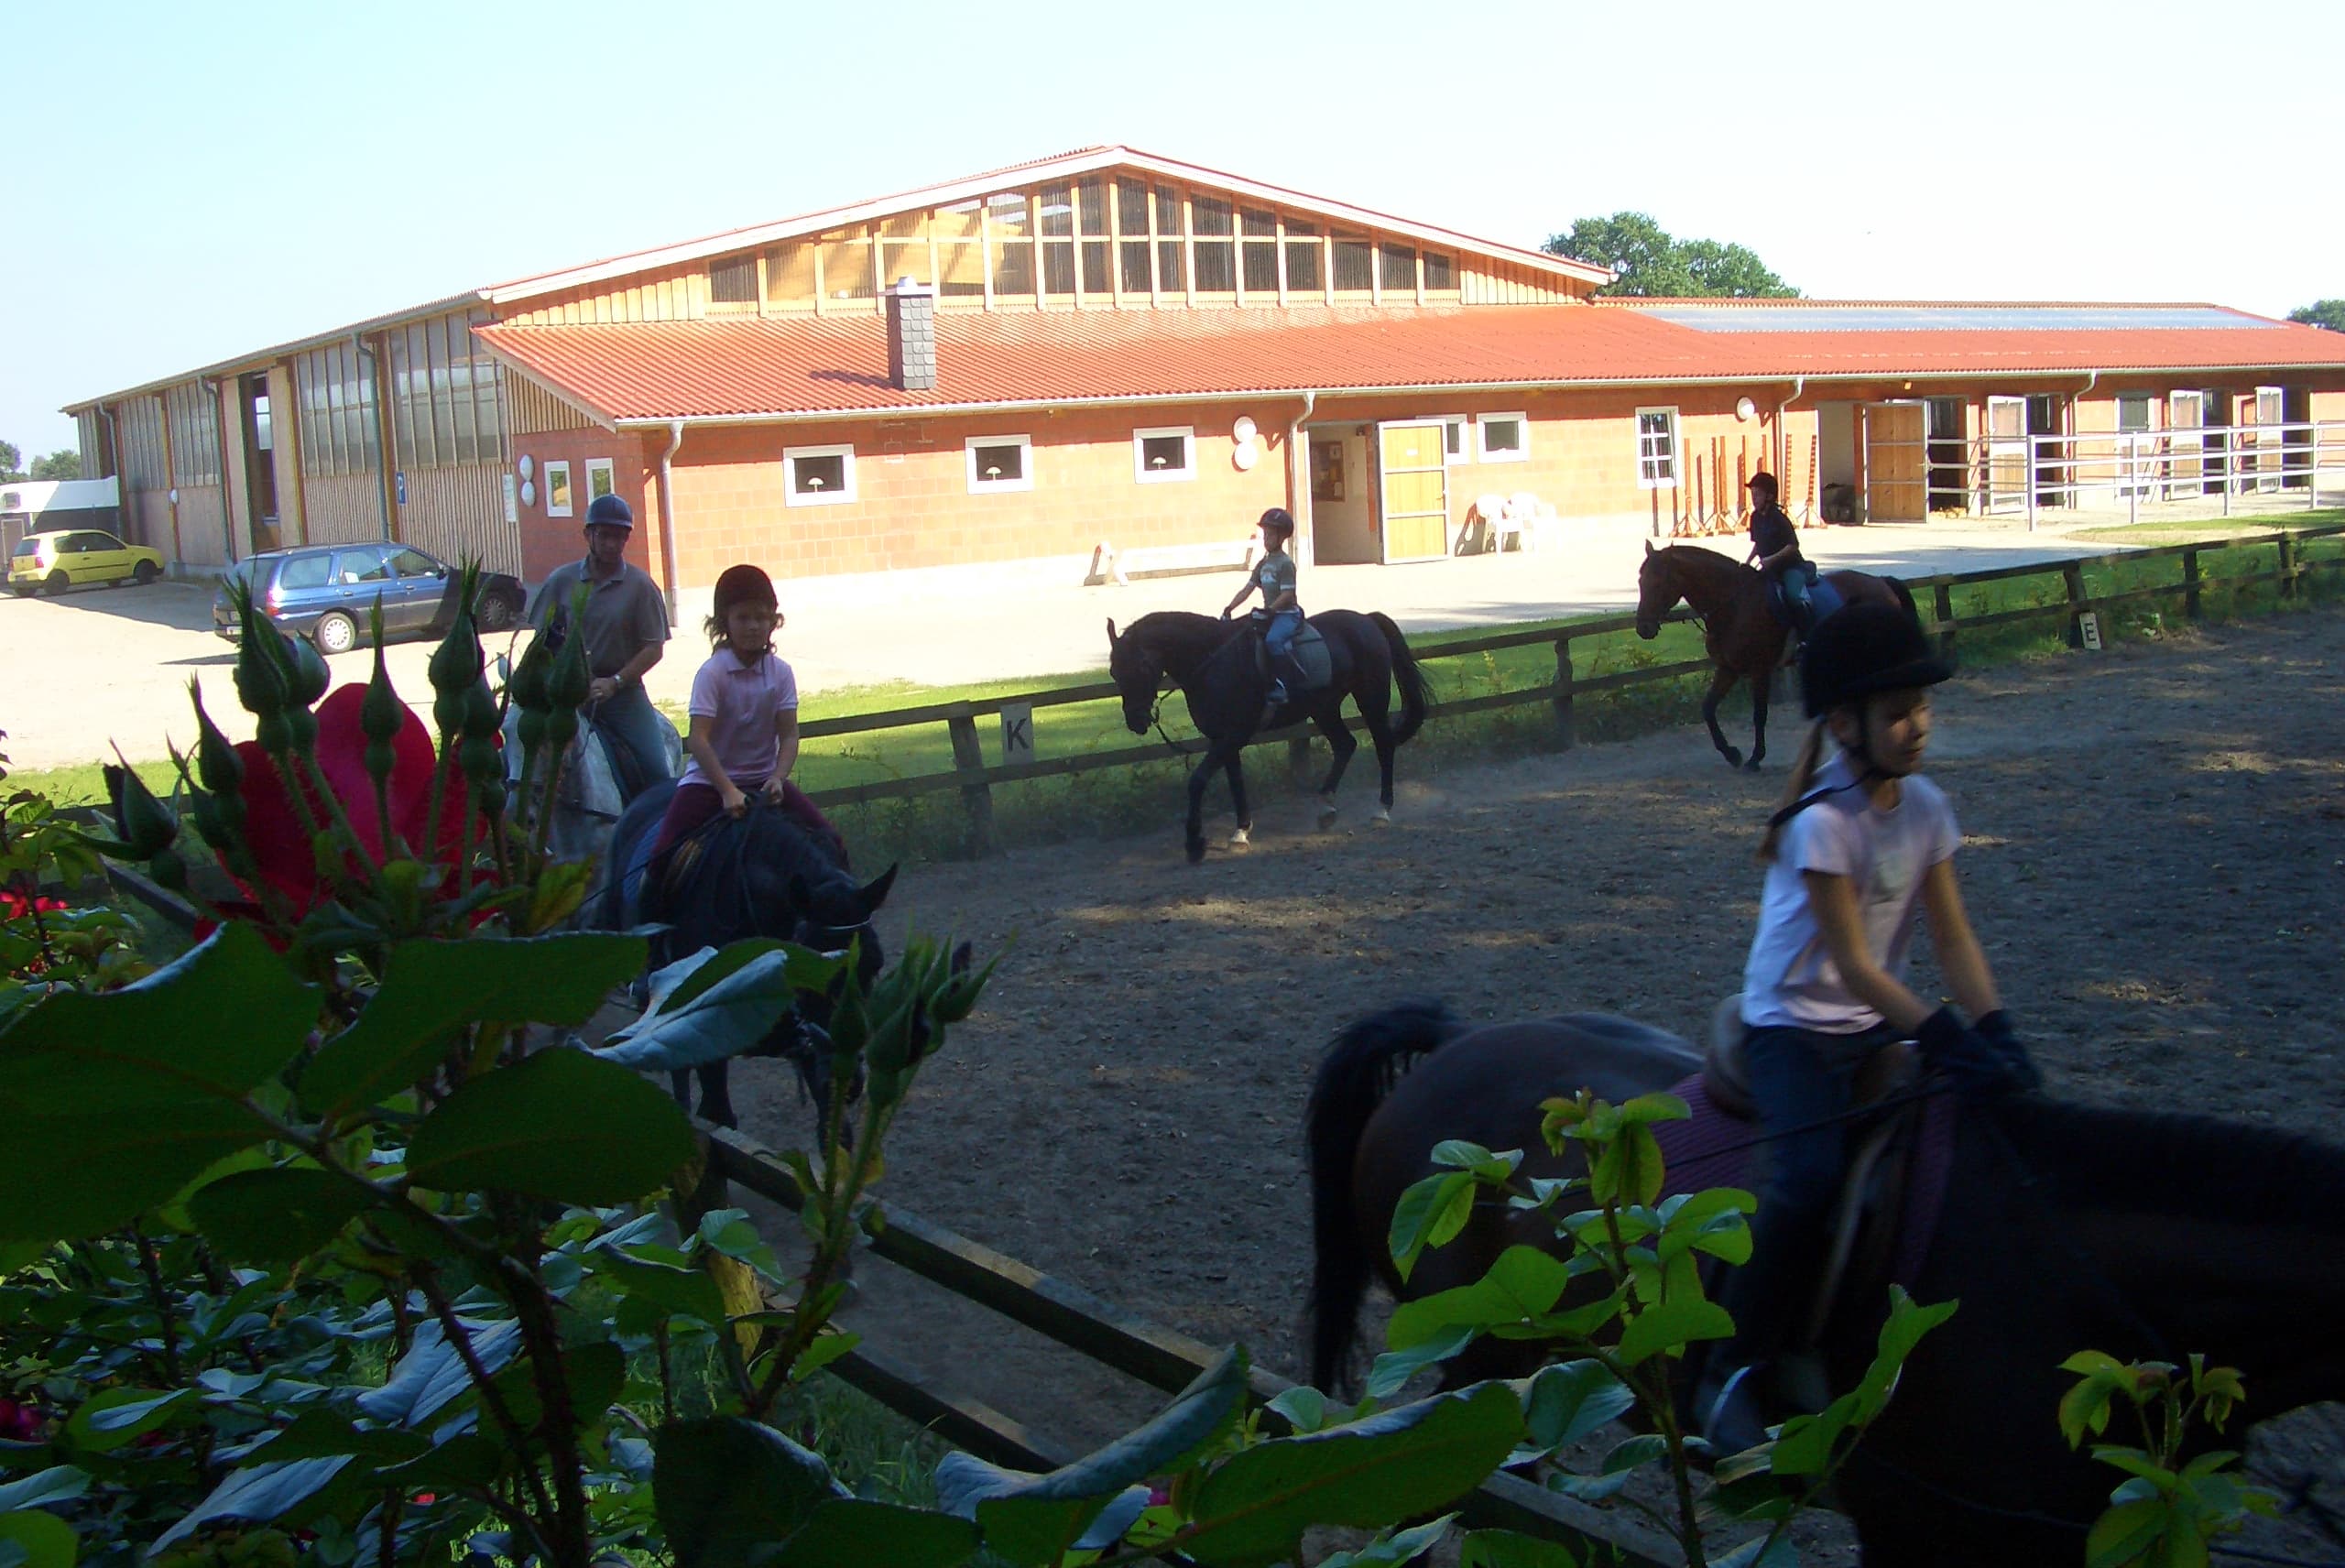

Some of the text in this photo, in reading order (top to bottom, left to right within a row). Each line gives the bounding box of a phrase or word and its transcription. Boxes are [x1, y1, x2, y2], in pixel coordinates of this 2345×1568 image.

[398, 475, 404, 501] P
[2084, 623, 2097, 641] E
[1007, 718, 1029, 751] K
